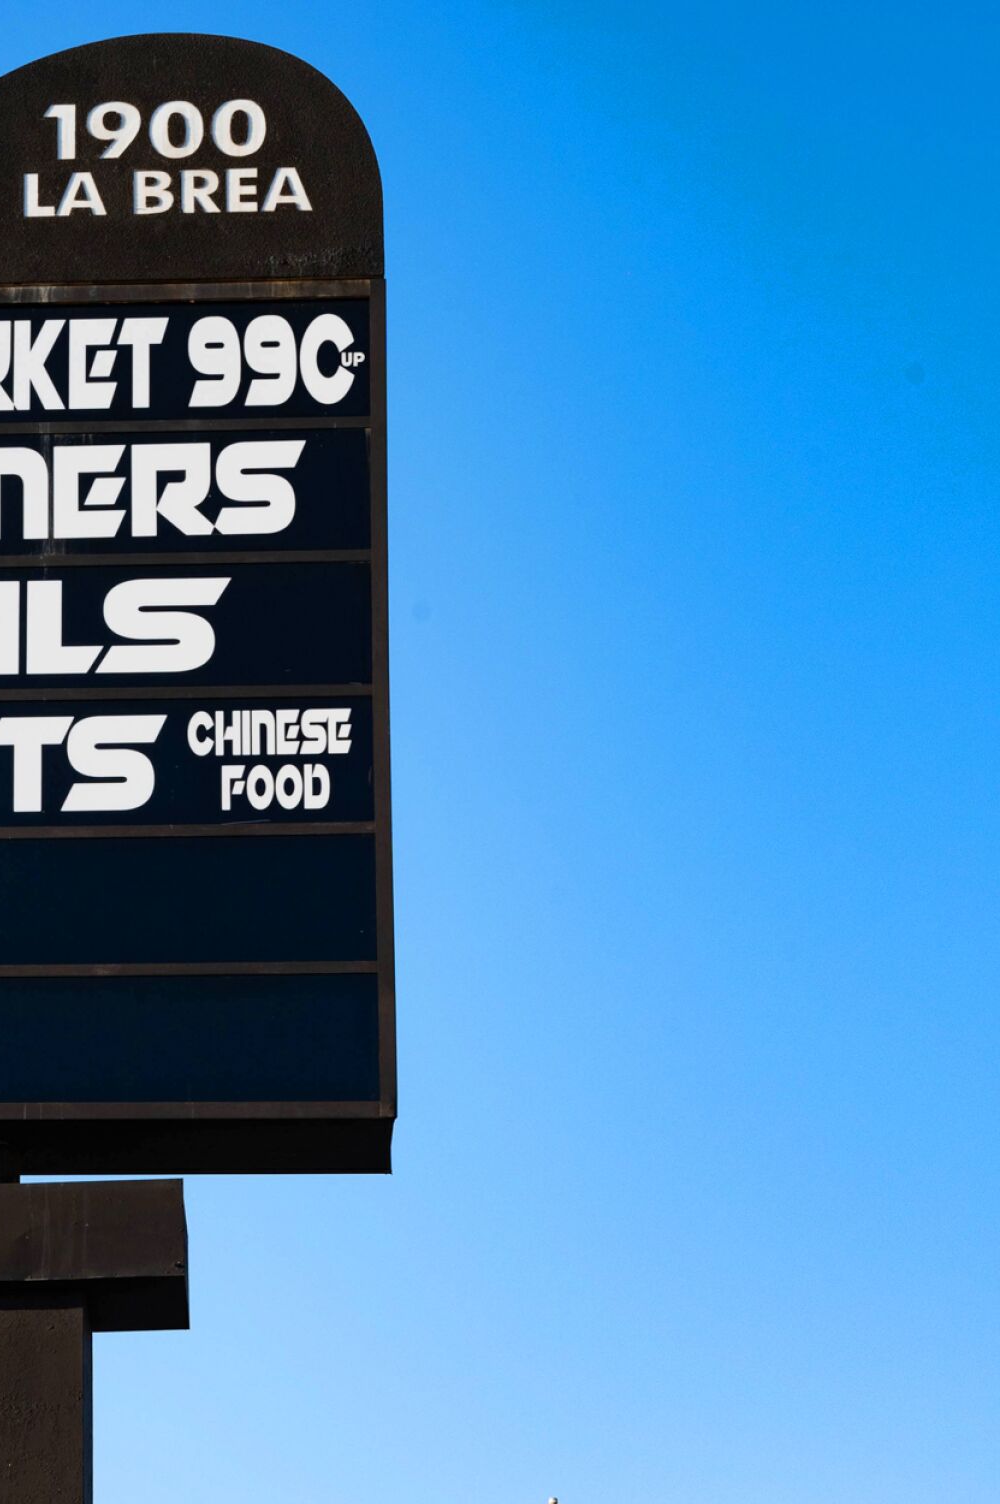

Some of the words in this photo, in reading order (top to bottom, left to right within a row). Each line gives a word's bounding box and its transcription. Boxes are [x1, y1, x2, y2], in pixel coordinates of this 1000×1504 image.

[45, 100, 267, 160] 1900
[24, 172, 107, 218] LA
[134, 167, 312, 215] BREA
[341, 352, 365, 367] UP
[187, 708, 352, 757] CHINESE
[221, 764, 331, 811] FOOD
